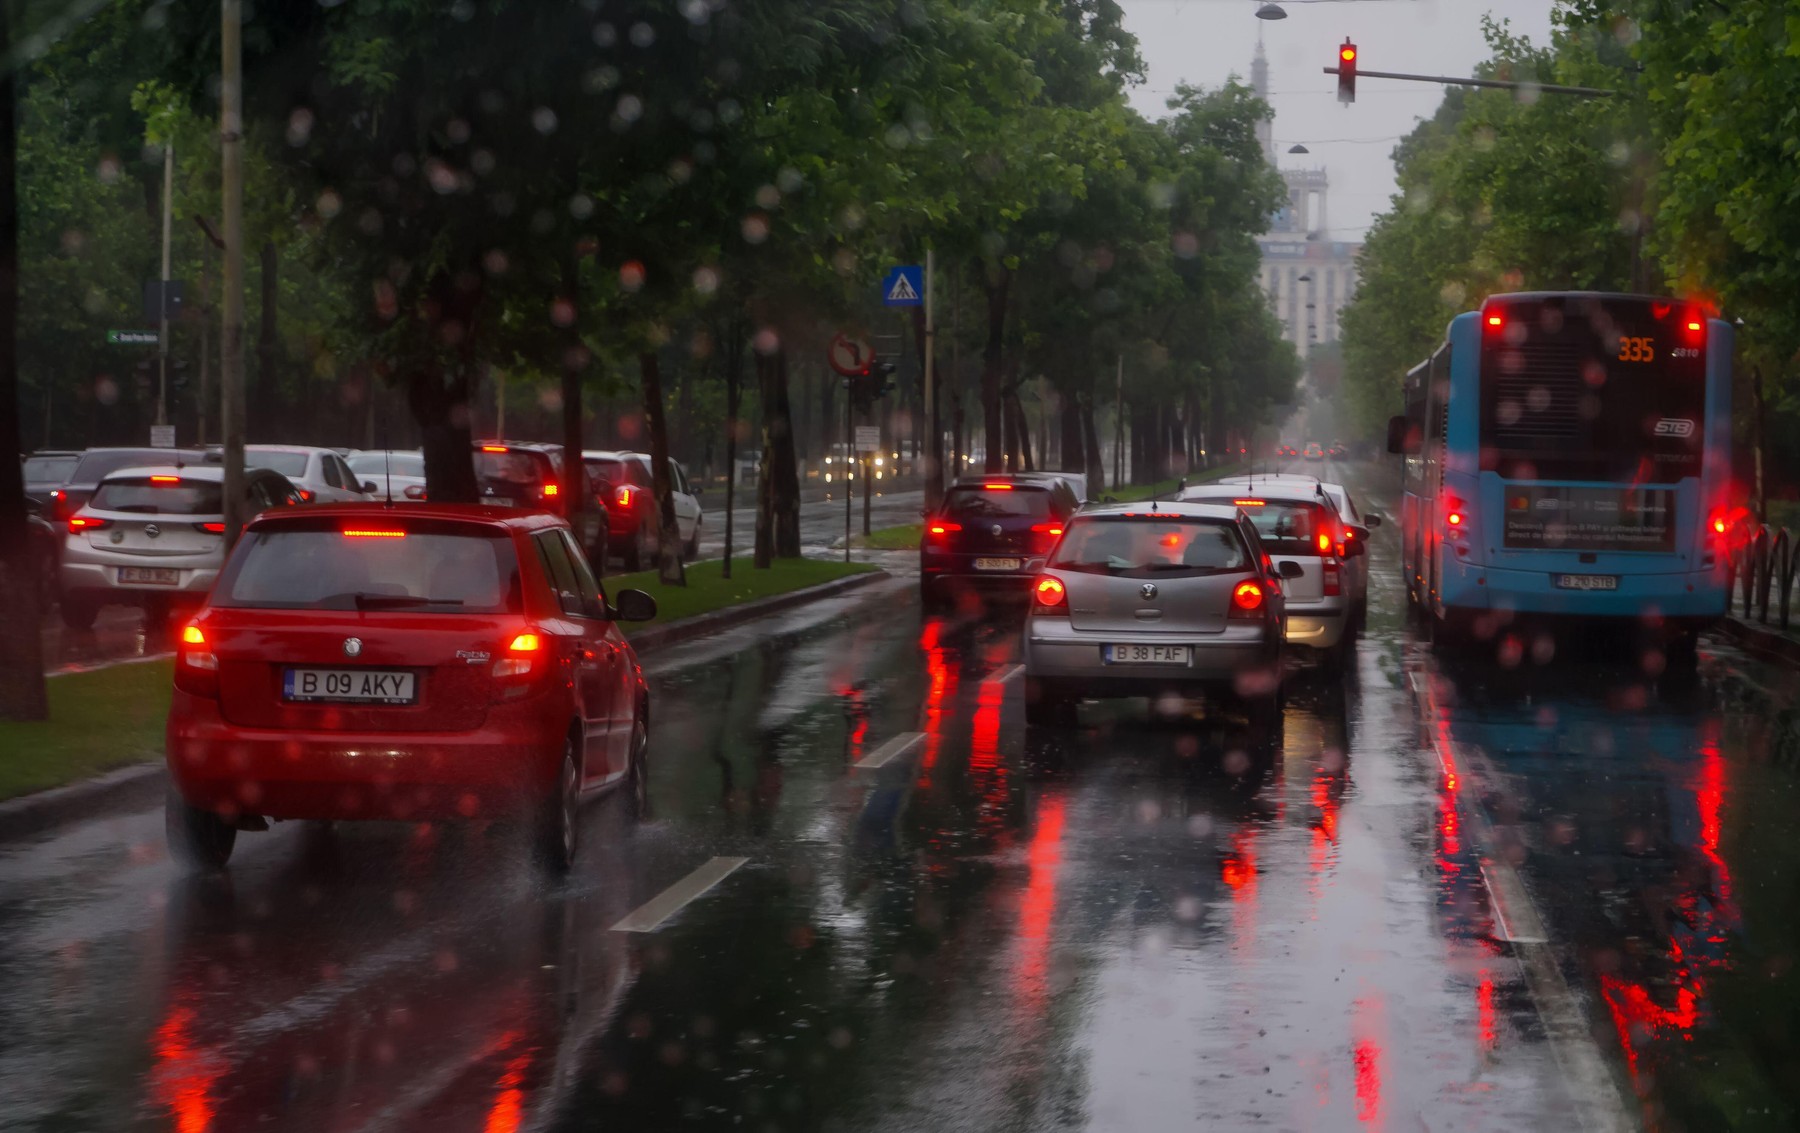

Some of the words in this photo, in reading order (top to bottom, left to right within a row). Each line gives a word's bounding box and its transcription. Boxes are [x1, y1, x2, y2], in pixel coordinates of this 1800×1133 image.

[1618, 336, 1655, 362] 335
[1654, 420, 1692, 434] STB
[1563, 575, 1570, 586] B
[1592, 576, 1614, 587] STB
[1117, 646, 1127, 660] B
[1132, 647, 1149, 660] 38
[1154, 647, 1182, 661] FAF
[302, 672, 318, 694] B
[326, 673, 352, 694] 09
[361, 674, 405, 696] AKY
